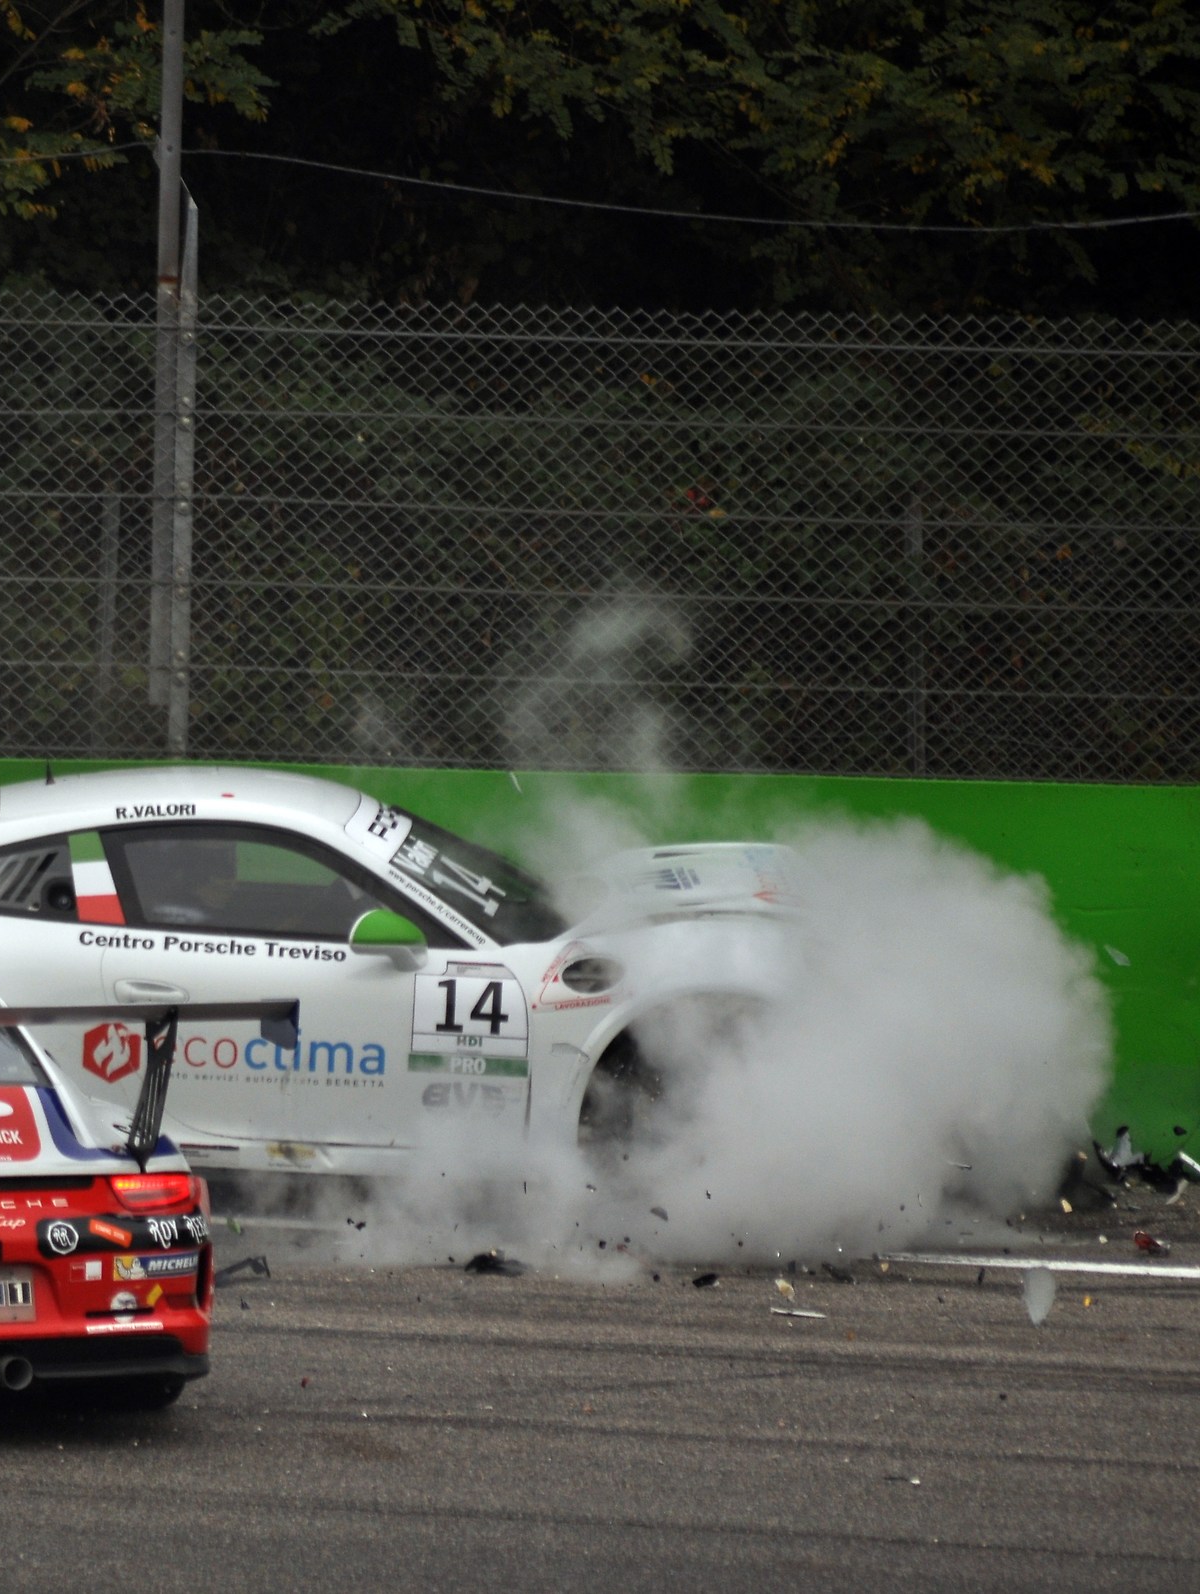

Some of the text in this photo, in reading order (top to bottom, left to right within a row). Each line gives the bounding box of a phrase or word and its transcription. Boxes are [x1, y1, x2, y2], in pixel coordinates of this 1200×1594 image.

[115, 803, 197, 820] R.VALORI
[78, 930, 347, 963] Centro Porsche Treviso
[435, 978, 509, 1035] 14
[450, 1057, 487, 1075] PRO
[326, 1077, 385, 1089] BERETTA
[147, 1218, 179, 1249] ROY
[9, 1280, 29, 1305] 1
